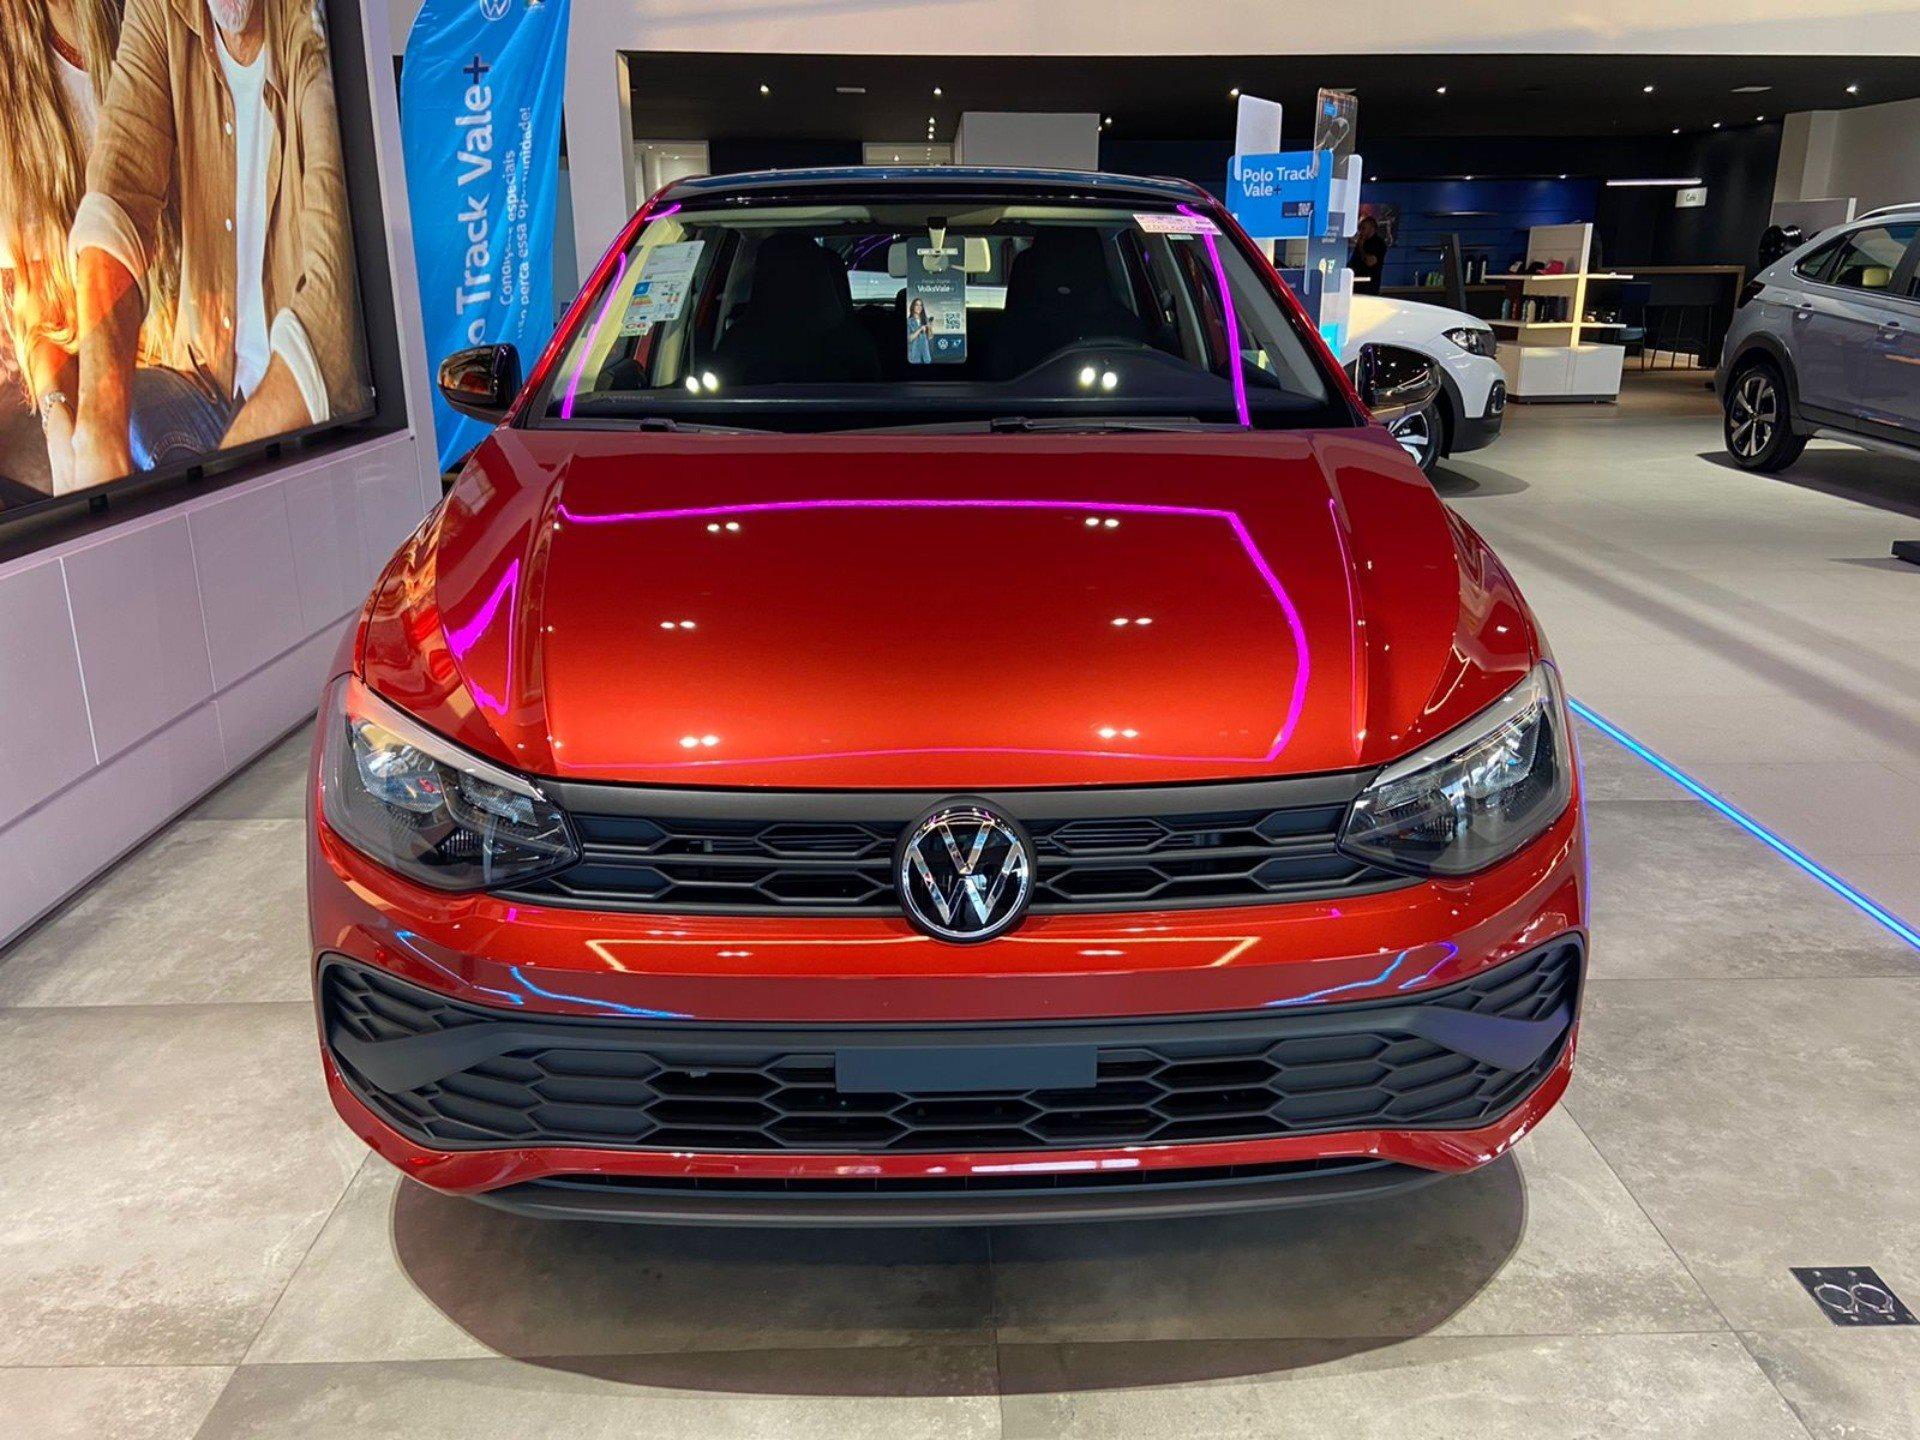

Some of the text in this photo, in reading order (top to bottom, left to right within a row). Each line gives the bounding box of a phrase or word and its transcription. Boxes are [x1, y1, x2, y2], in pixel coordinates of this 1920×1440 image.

[502, 150, 519, 222] especiais
[1242, 165, 1315, 182] Polo Track
[455, 192, 491, 316] Track
[517, 222, 529, 259] essa
